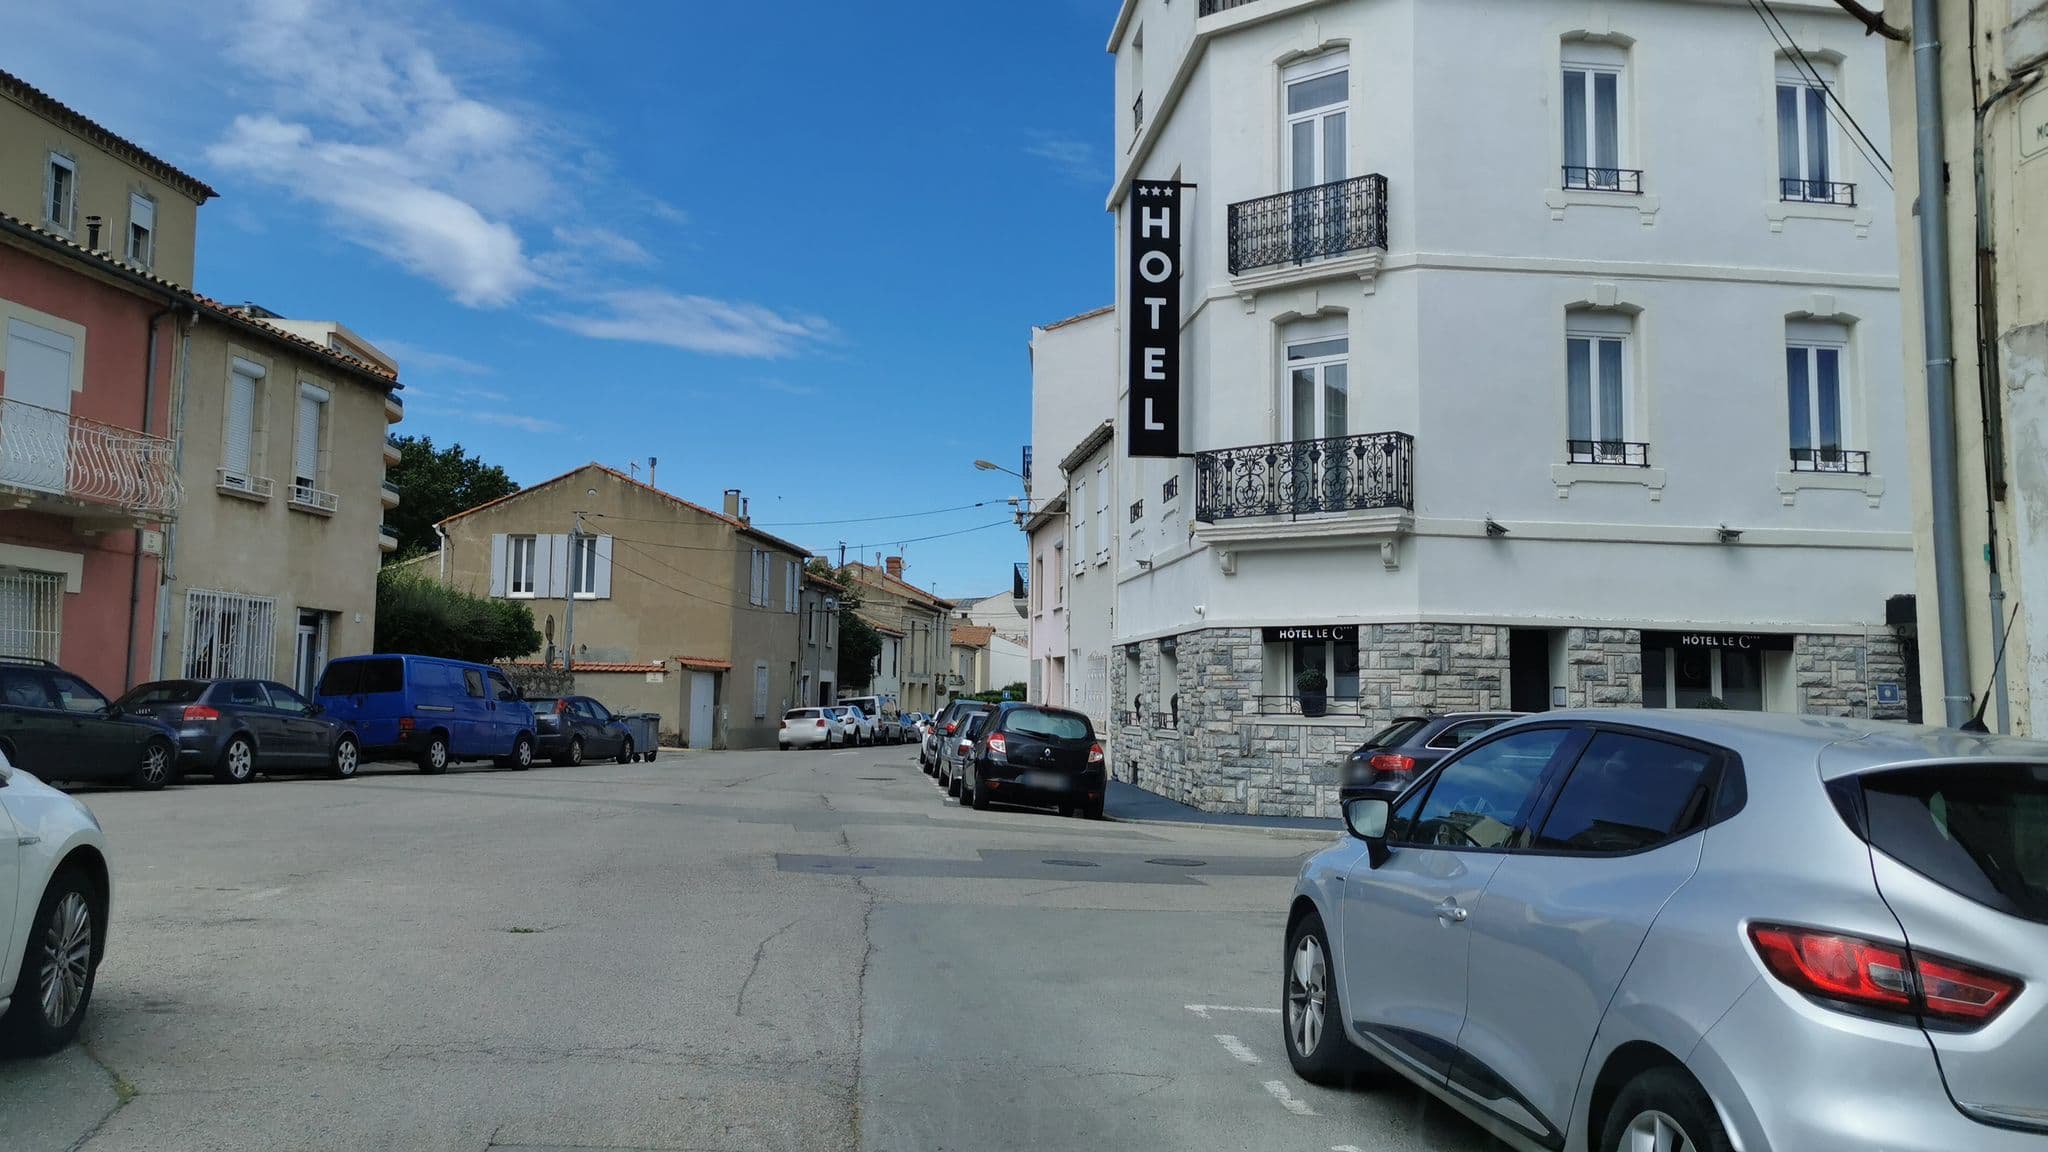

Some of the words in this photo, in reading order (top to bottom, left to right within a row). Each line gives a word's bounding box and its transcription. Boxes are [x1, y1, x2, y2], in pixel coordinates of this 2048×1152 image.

[1139, 206, 1172, 430] HOTEL
[1279, 628, 1313, 639] HÔTEL
[1316, 629, 1328, 638] LE
[1332, 626, 1343, 640] C
[1682, 633, 1719, 645] HÔTEL
[1722, 636, 1735, 646] LE
[1739, 635, 1750, 649] C
